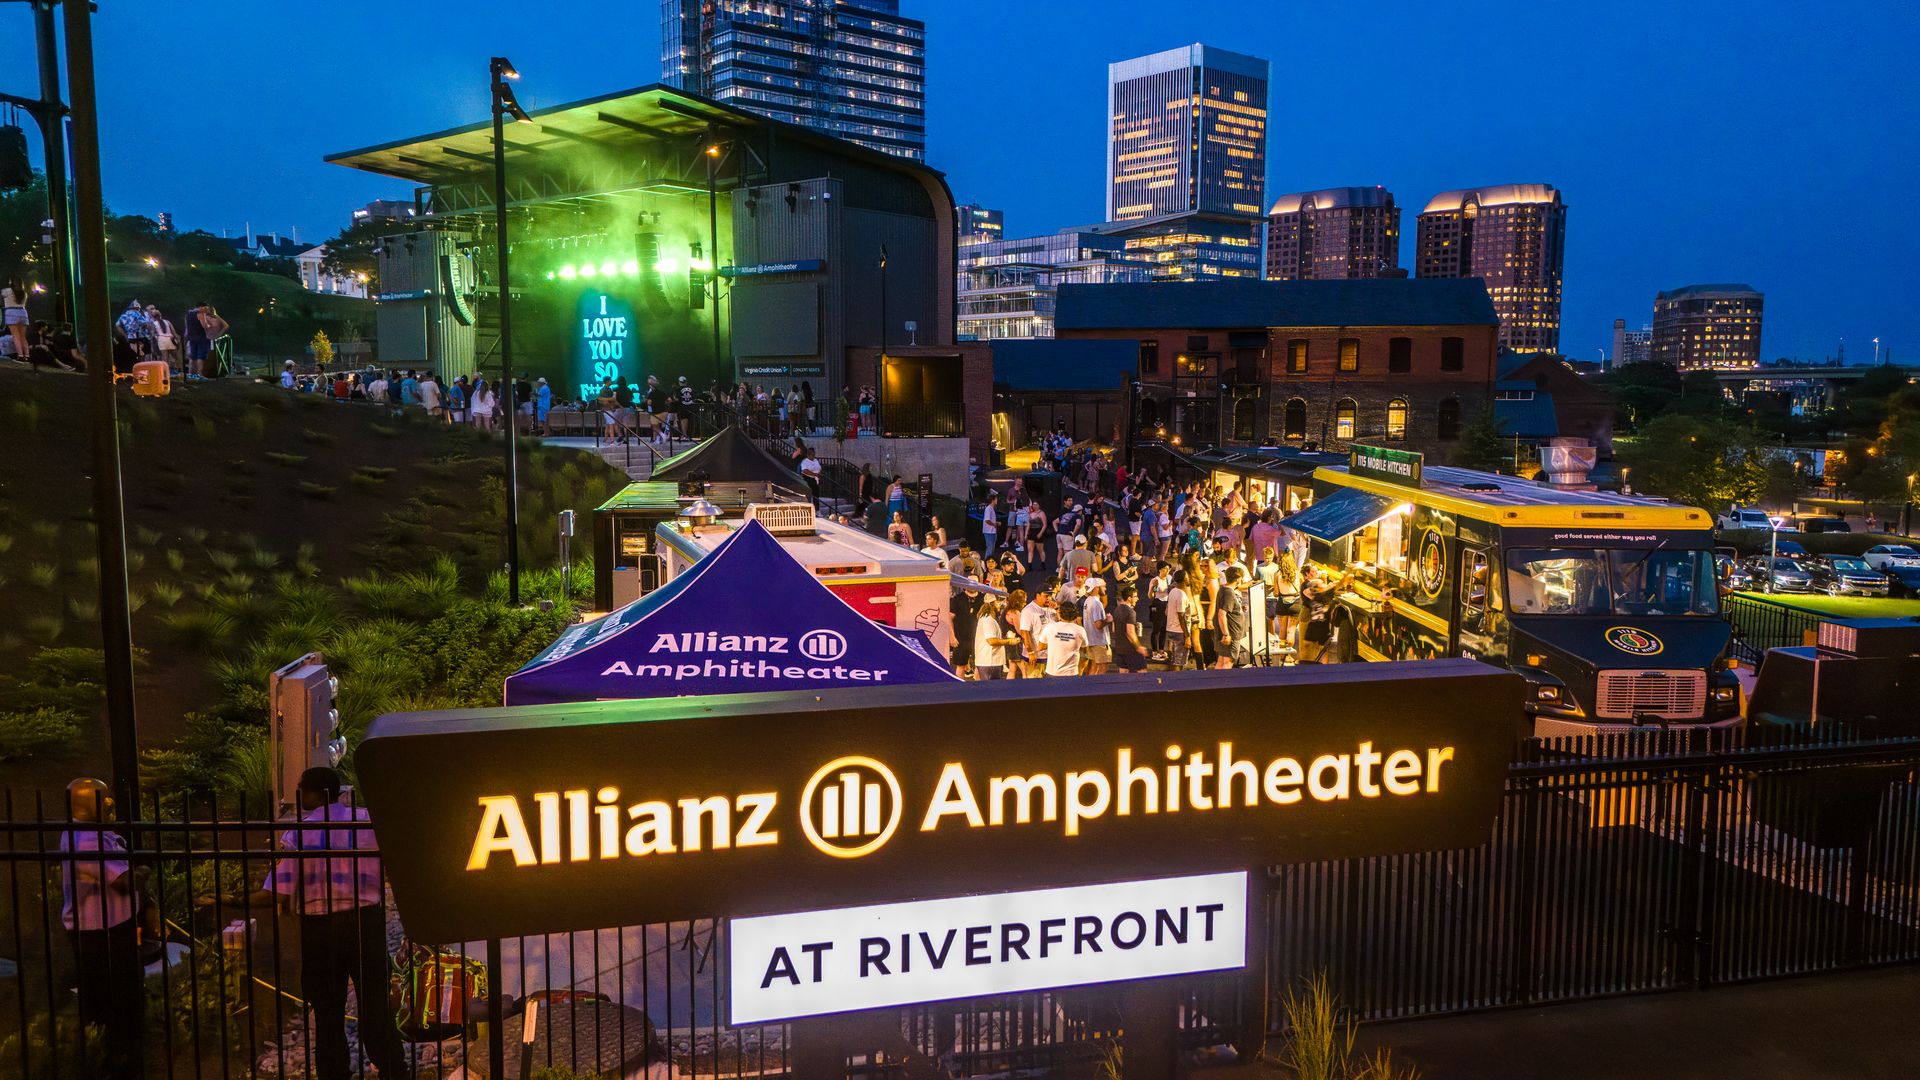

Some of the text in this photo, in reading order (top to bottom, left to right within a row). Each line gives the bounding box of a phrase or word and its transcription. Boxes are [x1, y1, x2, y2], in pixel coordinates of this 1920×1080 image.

[763, 263, 797, 272] Amphitheater
[600, 296, 607, 315] I
[583, 317, 627, 338] LOVE
[588, 340, 623, 360] YOU
[594, 362, 619, 382] SO
[1367, 457, 1386, 471] MOBILE
[1387, 460, 1412, 476] KITCHEN
[649, 632, 788, 653] Allianz
[600, 659, 889, 681] Amphitheater
[466, 741, 1455, 871] Allianz Amphitheater
[760, 902, 1225, 989] AT RIVERFRONT
